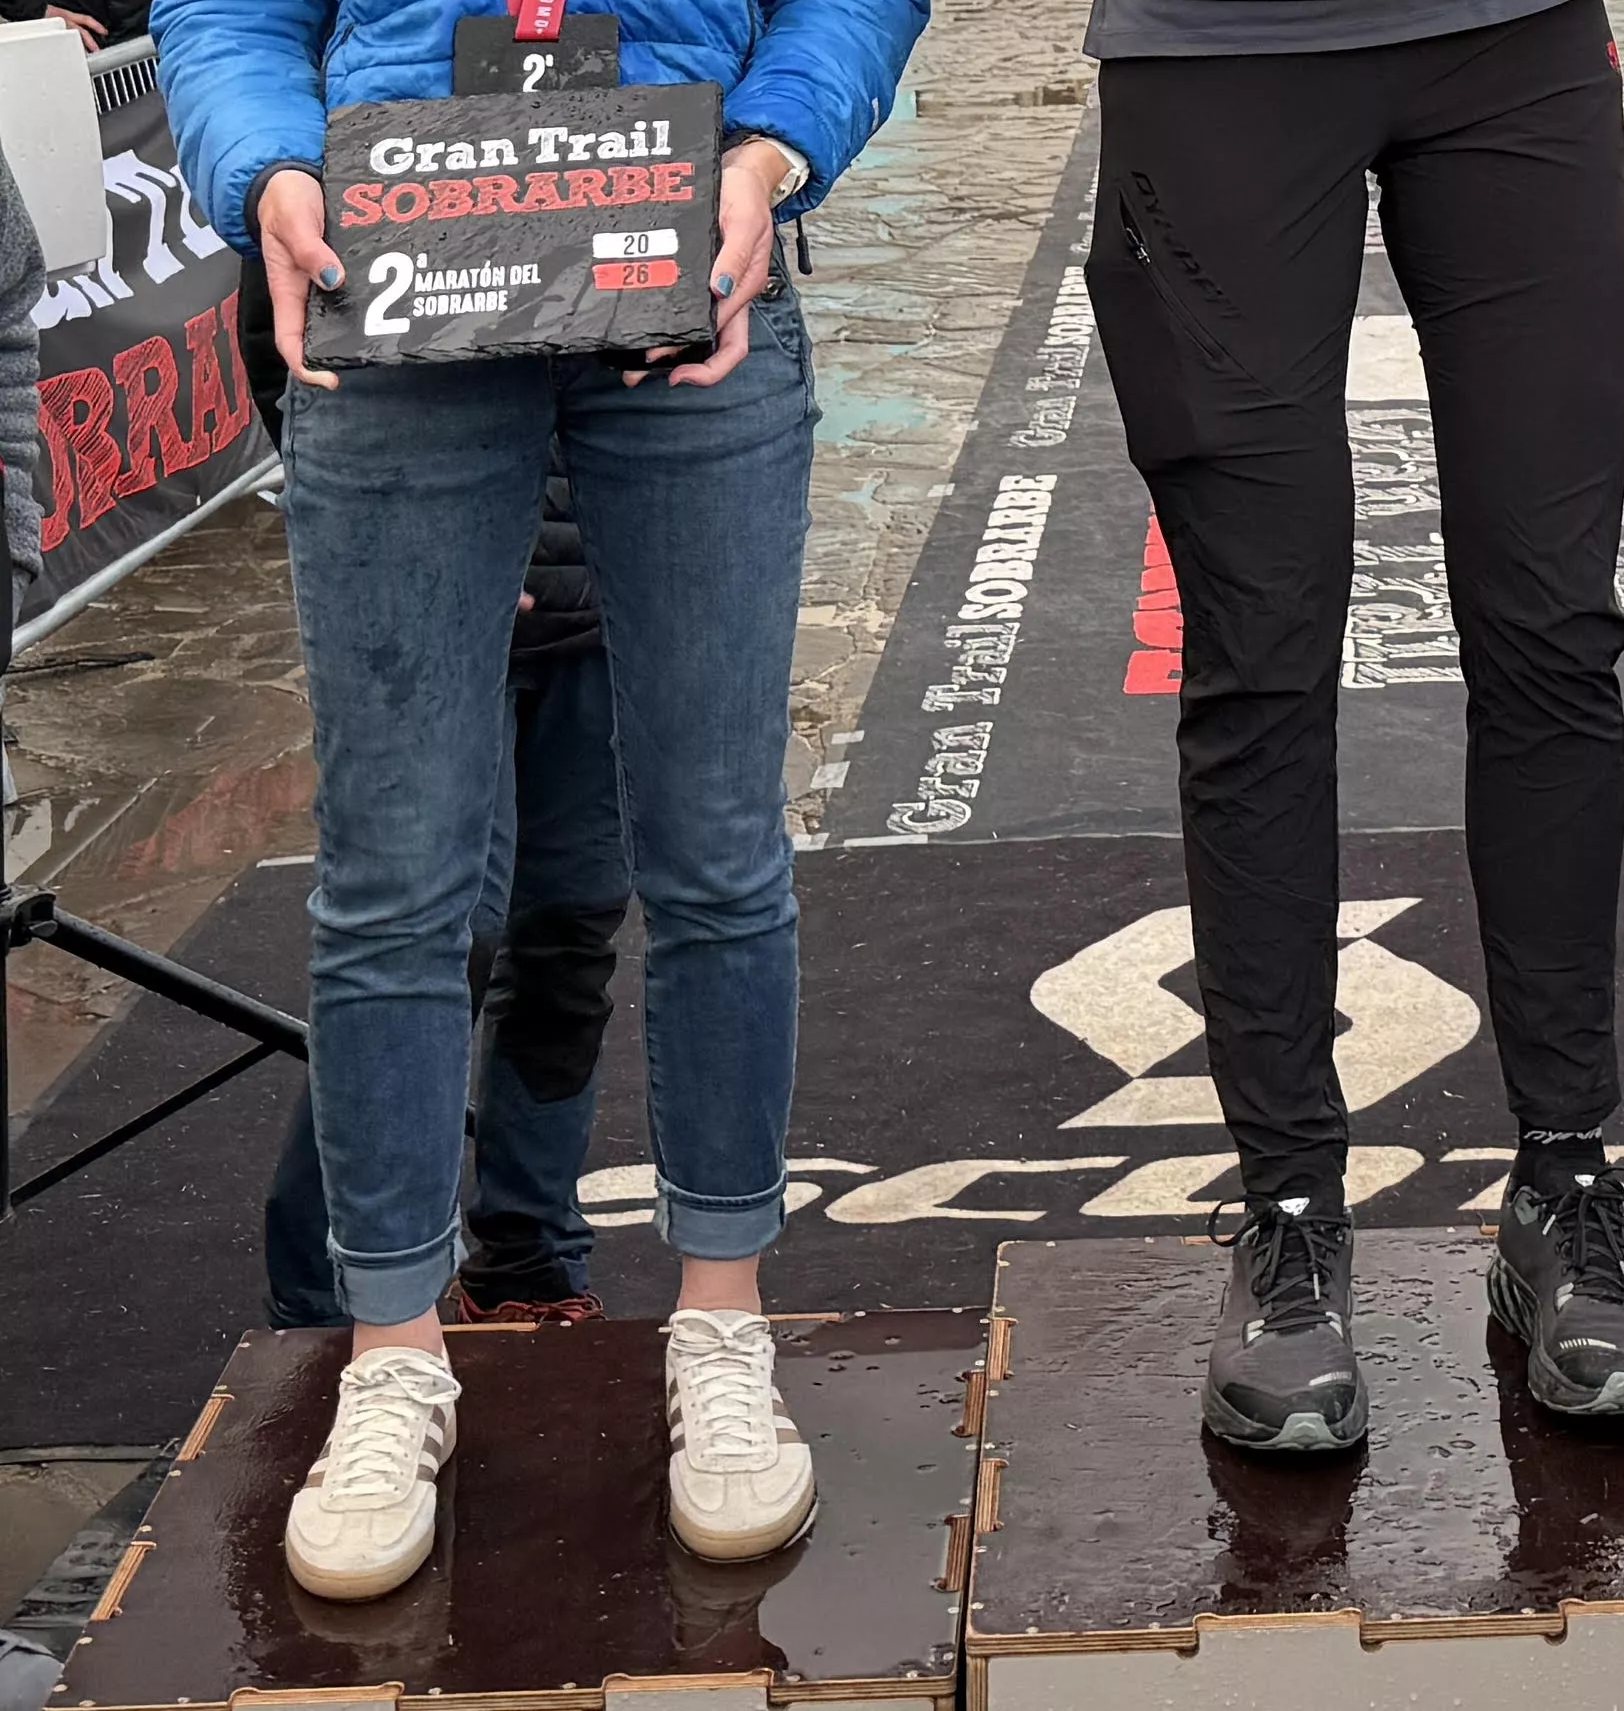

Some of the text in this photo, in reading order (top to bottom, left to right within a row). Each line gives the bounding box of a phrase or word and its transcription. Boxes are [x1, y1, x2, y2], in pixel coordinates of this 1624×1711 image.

[369, 120, 673, 177] Gran Trail
[339, 162, 694, 228] SOBRARBE
[622, 233, 649, 256] 20
[414, 259, 542, 293] MARATÓN DEL
[622, 263, 649, 286] 26
[412, 290, 509, 318] SOBRARBE
[887, 473, 1058, 834] Gran Trail SOBRARBE
